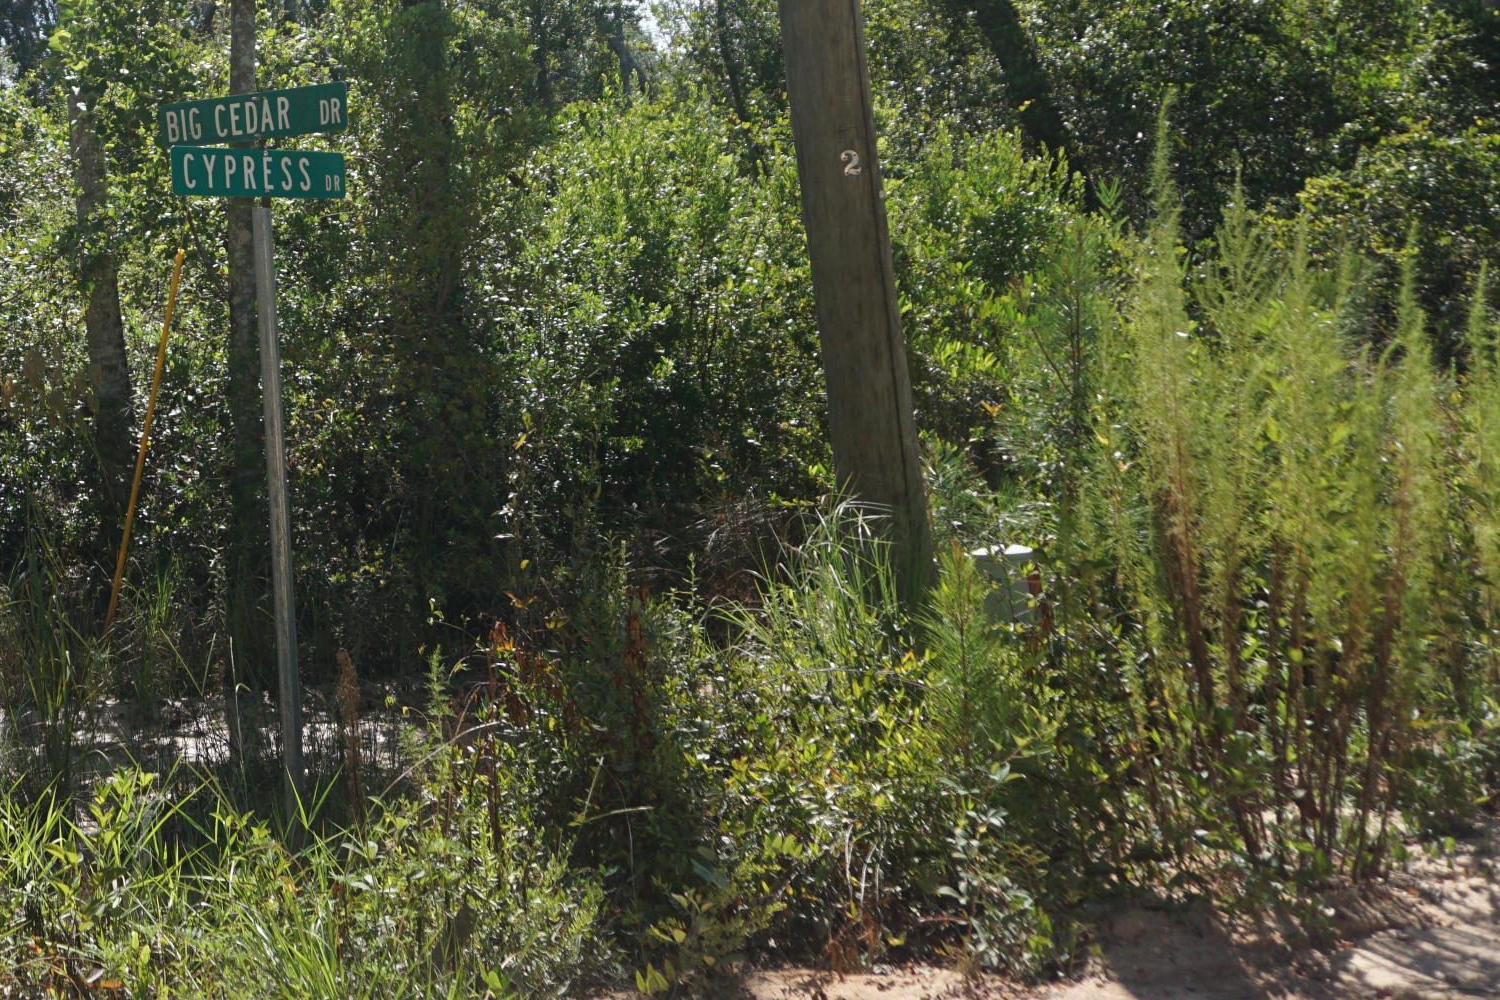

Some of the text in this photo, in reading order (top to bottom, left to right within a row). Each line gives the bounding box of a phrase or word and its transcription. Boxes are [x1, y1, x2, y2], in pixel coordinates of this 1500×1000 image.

[166, 96, 341, 143] BIG CEDAR DR
[183, 153, 341, 191] CYPRESS DR
[840, 149, 862, 177] 2
